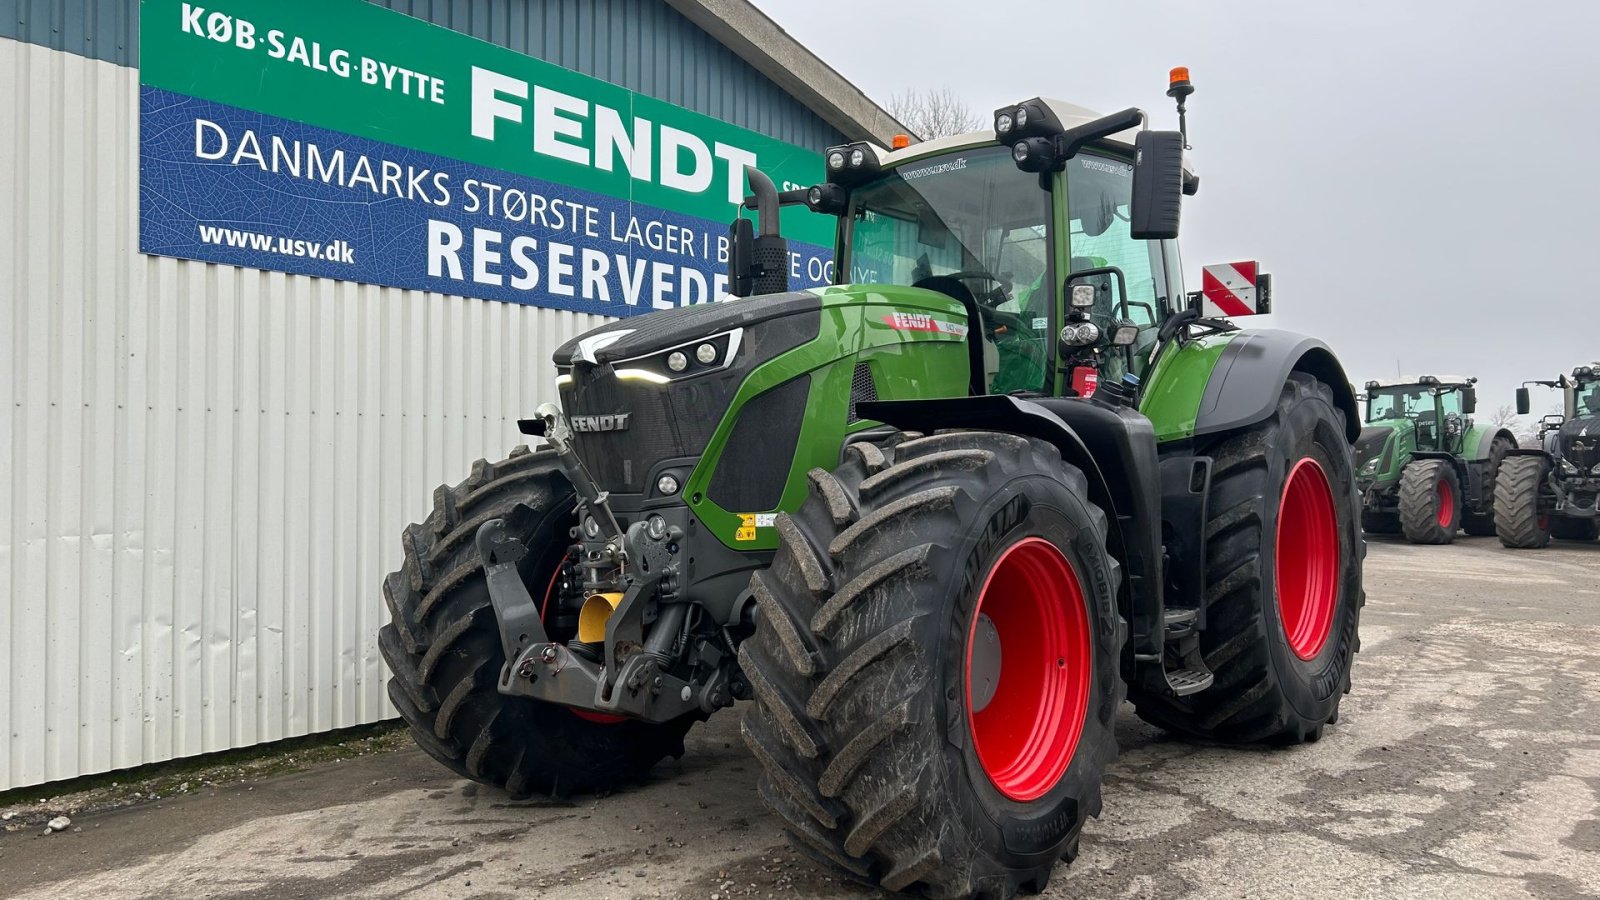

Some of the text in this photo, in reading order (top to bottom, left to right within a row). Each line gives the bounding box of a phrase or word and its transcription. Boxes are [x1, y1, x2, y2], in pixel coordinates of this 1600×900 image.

[470, 65, 757, 205] FENDT
[902, 157, 968, 181] www.usv.dk
[195, 117, 452, 207] DANMARKS
[463, 178, 599, 238] STØRSTE
[610, 211, 696, 257] LAGER
[198, 225, 355, 265] www.usv.dk
[891, 311, 932, 330] FENDT
[571, 413, 630, 432] FENDT
